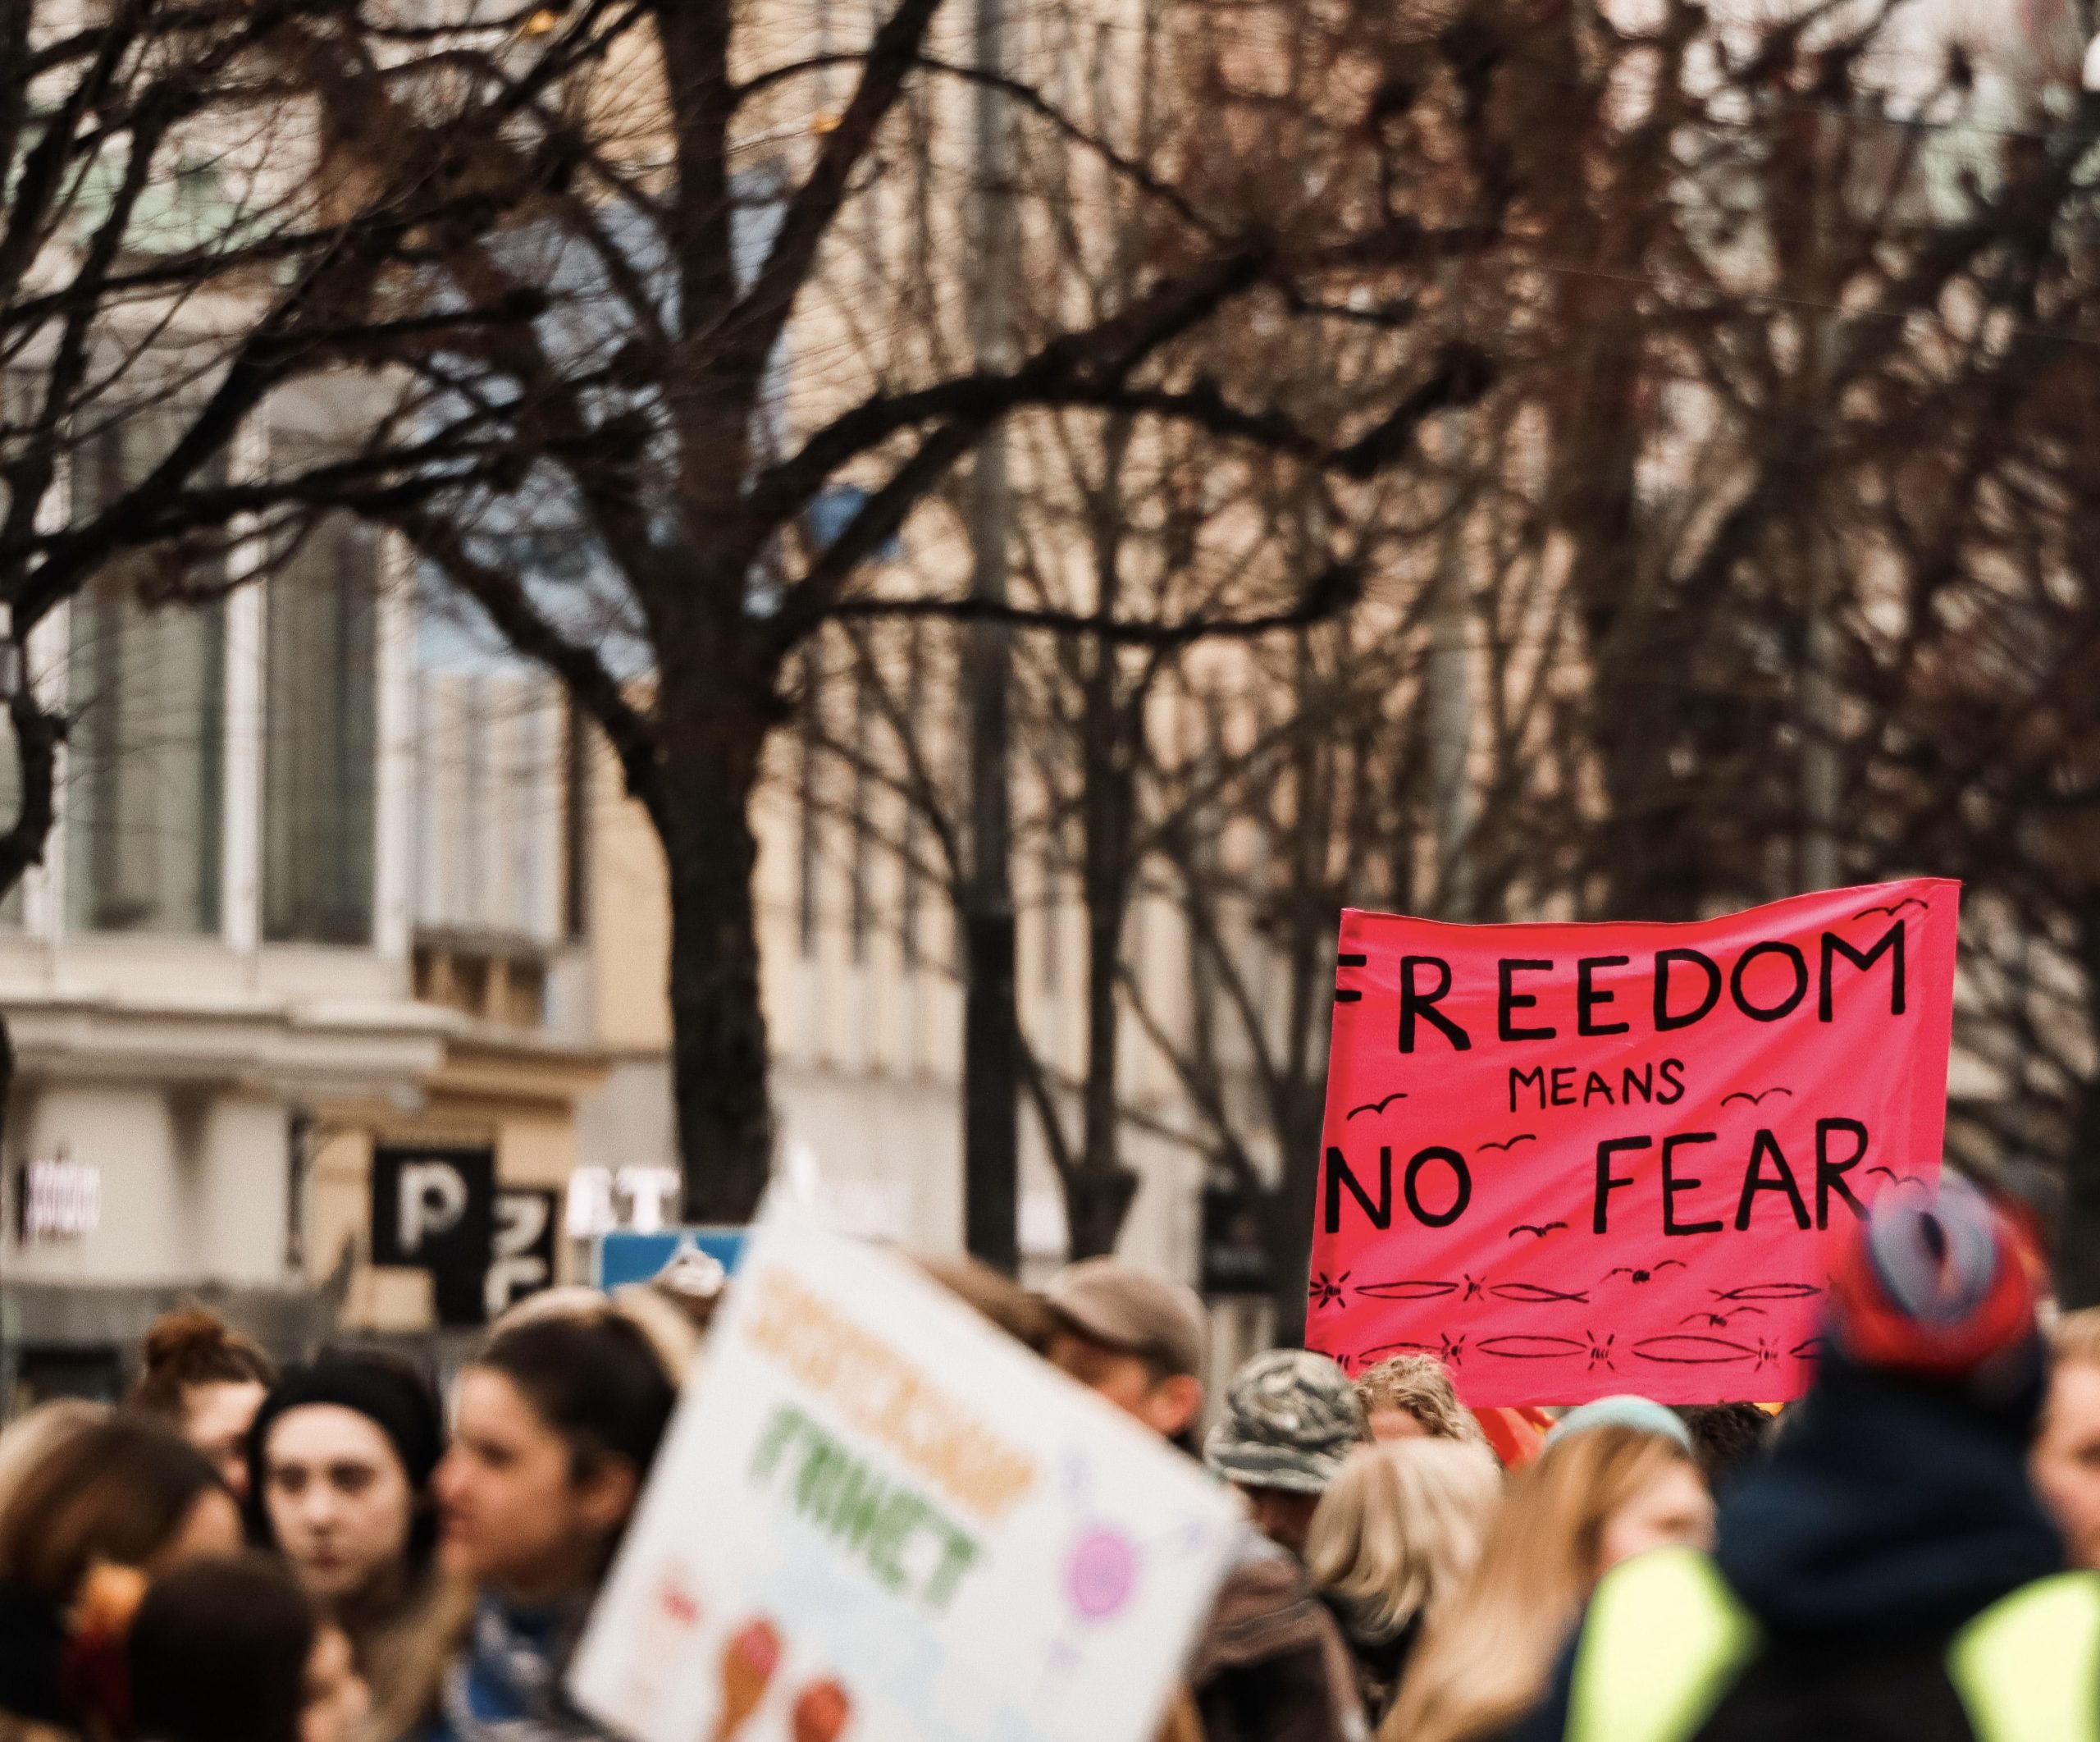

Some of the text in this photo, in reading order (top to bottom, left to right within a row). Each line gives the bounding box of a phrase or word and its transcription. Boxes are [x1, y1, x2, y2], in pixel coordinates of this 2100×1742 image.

[1509, 1058, 1685, 1113] MEANS
[1324, 1117, 1871, 1237] NO FEAR
